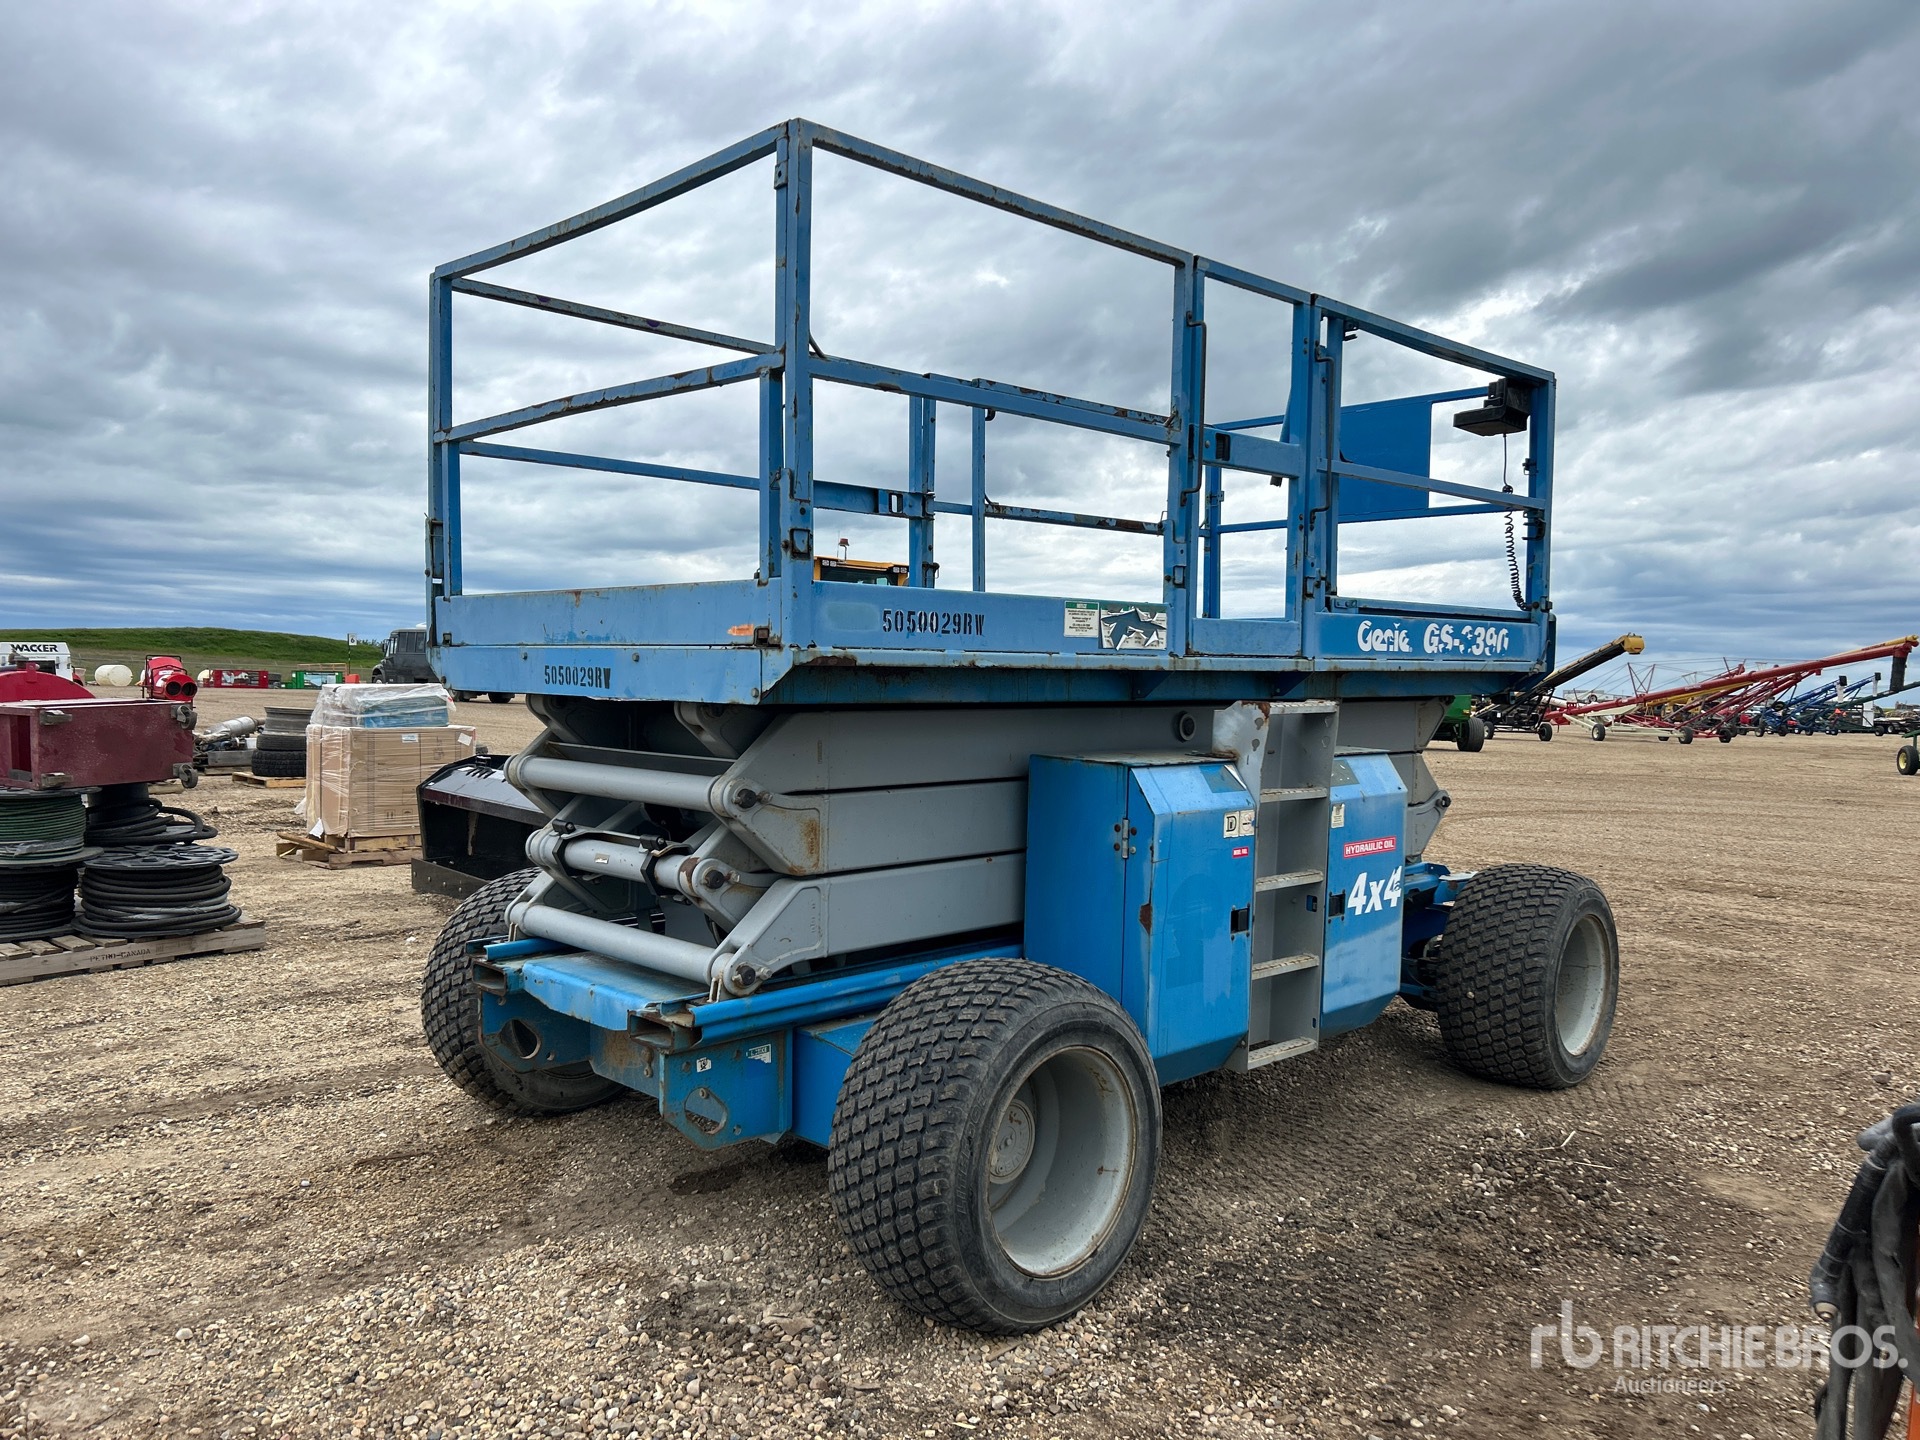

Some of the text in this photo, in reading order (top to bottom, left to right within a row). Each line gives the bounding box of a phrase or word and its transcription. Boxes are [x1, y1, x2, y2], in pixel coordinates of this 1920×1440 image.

[882, 608, 985, 636] 5050029RW
[1357, 620, 1412, 653] Genie
[10, 644, 58, 652] WACKER
[544, 665, 611, 689] 5050029RW
[1345, 839, 1394, 855] HYDRAULIC OIL
[90, 948, 151, 962] PETRO-CANADA
